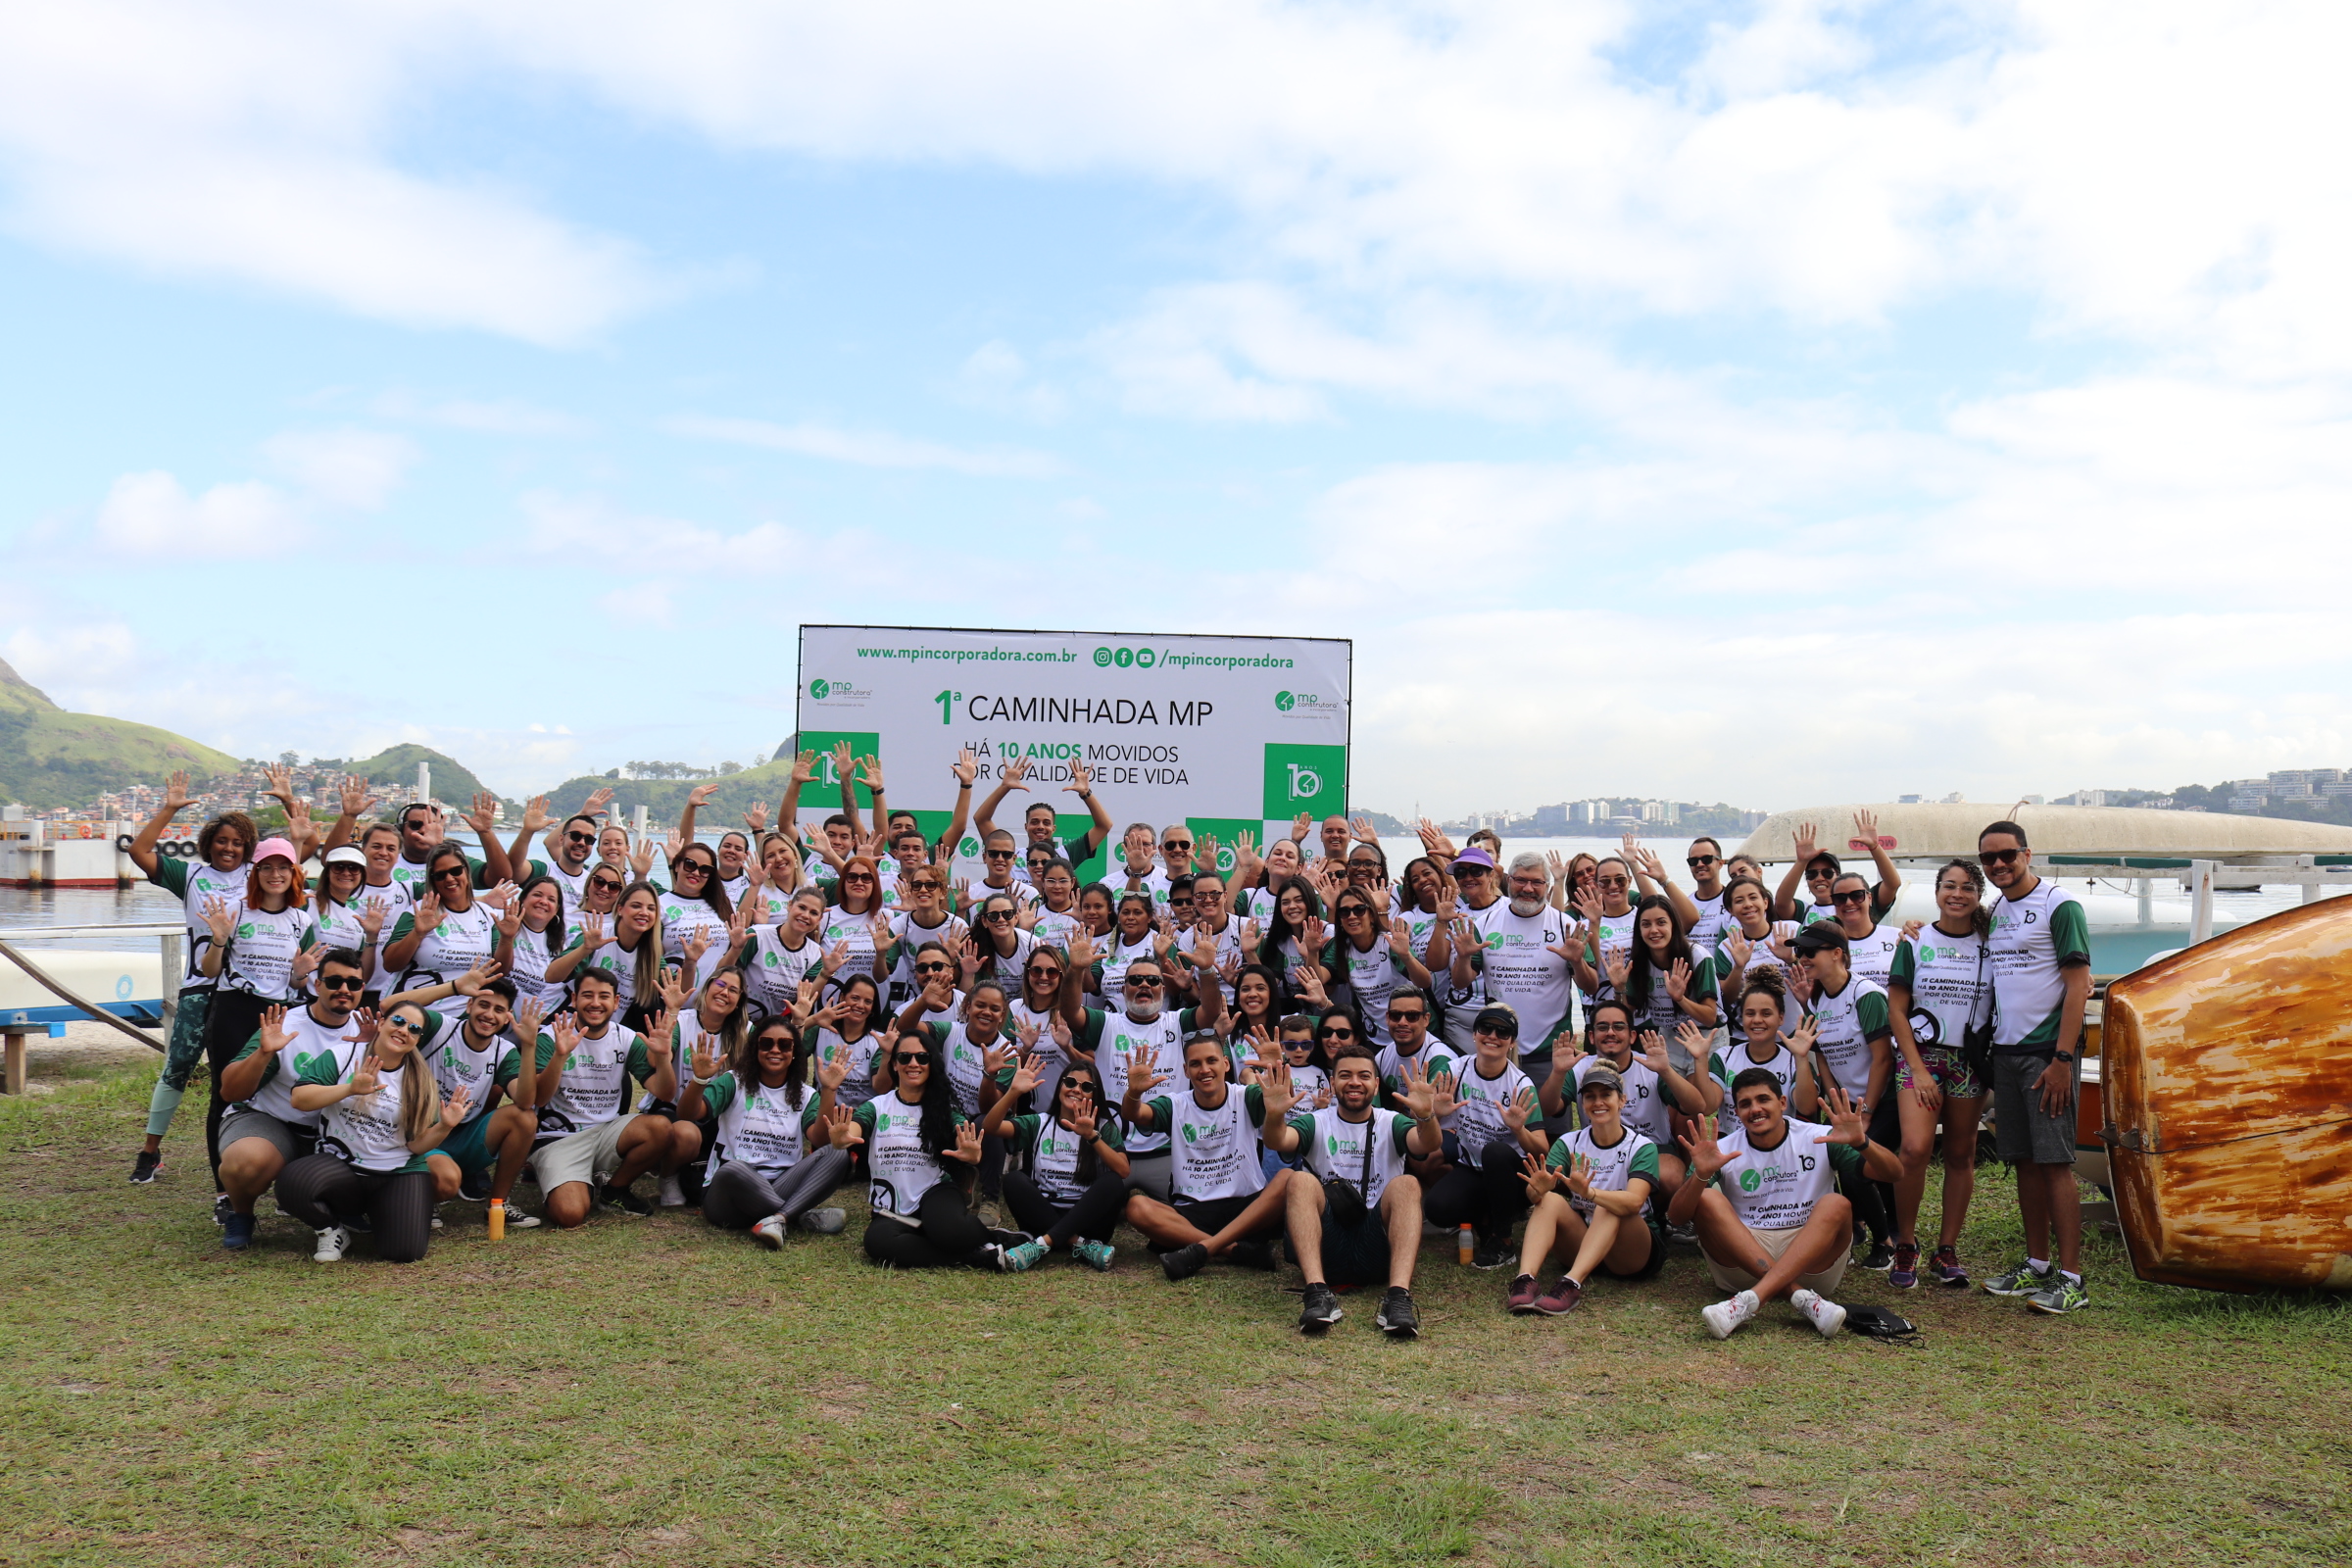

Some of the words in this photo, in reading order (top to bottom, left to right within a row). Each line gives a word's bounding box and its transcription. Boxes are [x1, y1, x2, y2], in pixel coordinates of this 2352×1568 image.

[857, 645, 1077, 663] www.mpincorporadora.com.br
[1158, 649, 1294, 670] /mpincorporadora
[832, 681, 852, 692] mp
[1298, 694, 1318, 704] mp
[968, 695, 1158, 725] CAMINHADA
[1168, 701, 1213, 726] MP
[965, 738, 991, 758] HÁ
[998, 742, 1019, 759] 10
[1025, 743, 1082, 760] ANOS
[1088, 744, 1179, 762] MOVIDOS
[1113, 767, 1138, 783] DE
[1144, 768, 1189, 785] VIDA
[257, 924, 275, 932] mp
[1937, 947, 1957, 956] mp
[1929, 978, 1975, 986] CAMINHADA
[1942, 993, 1983, 1001] QUALIDADE
[1820, 1010, 1832, 1019] mp
[1836, 1042, 1862, 1052] MOVIDOS
[578, 1055, 594, 1065] mp
[455, 1059, 471, 1073] mp
[350, 1109, 392, 1126] CAMINHADA
[744, 1128, 785, 1141] CAMINHADA
[1199, 1125, 1217, 1134] mp
[1339, 1140, 1358, 1150] mp
